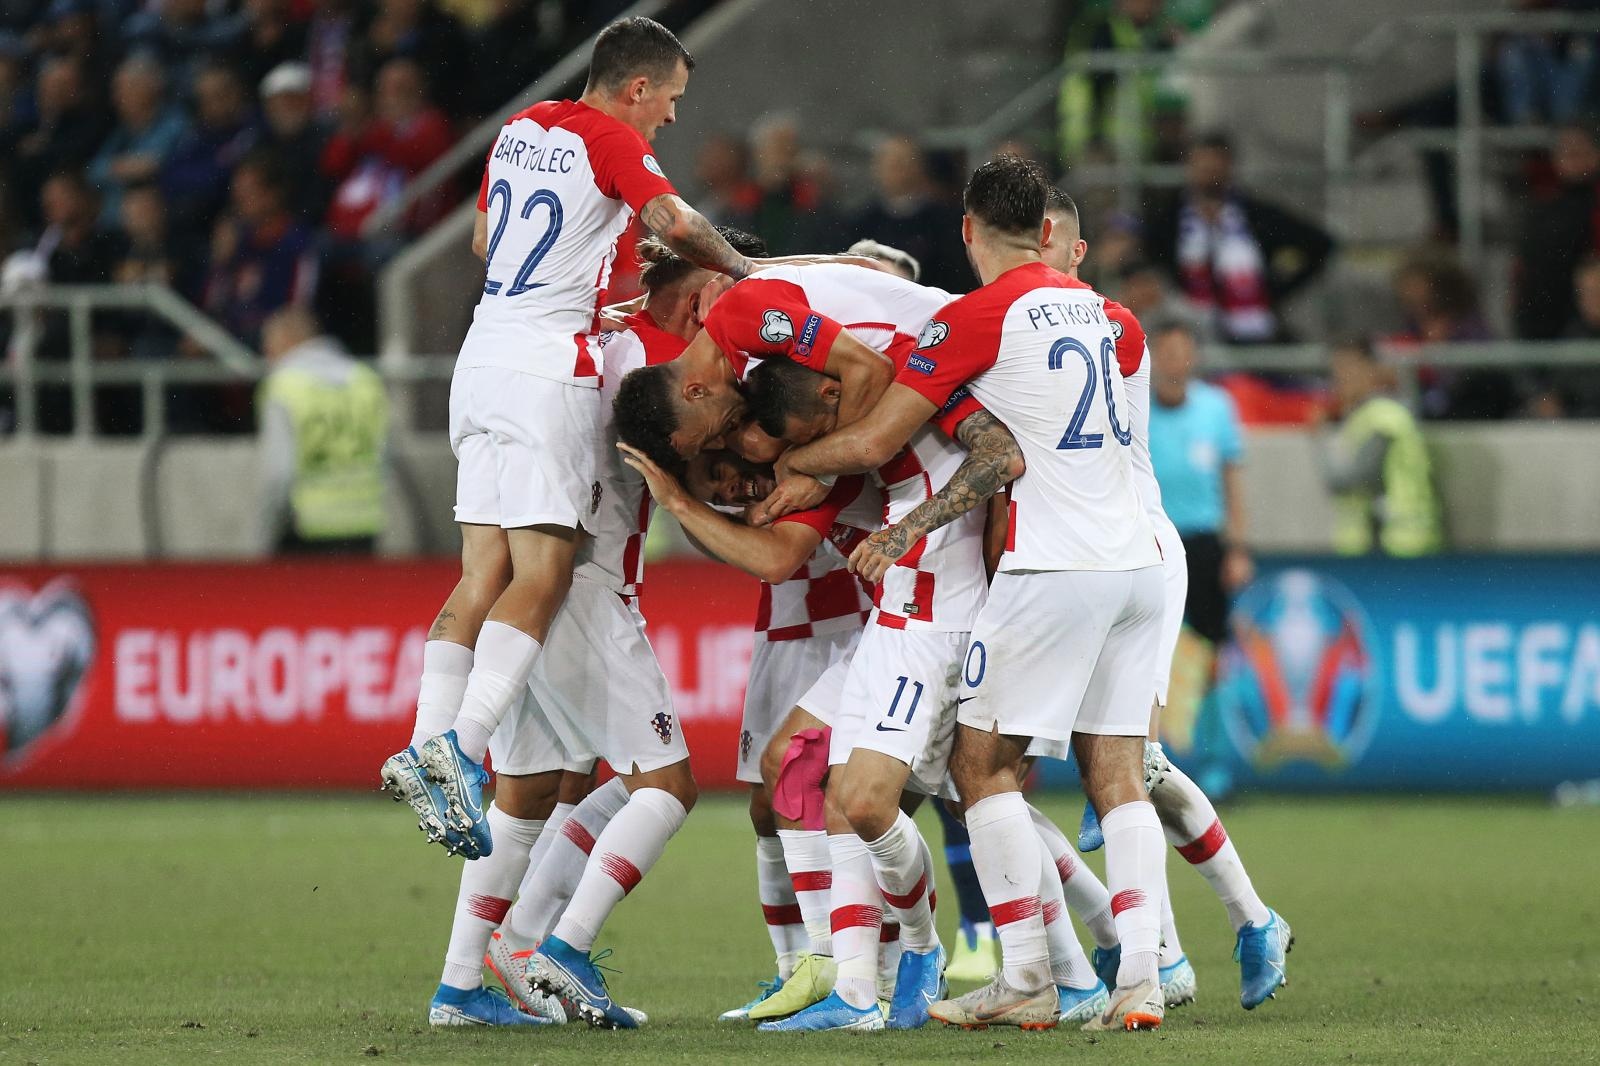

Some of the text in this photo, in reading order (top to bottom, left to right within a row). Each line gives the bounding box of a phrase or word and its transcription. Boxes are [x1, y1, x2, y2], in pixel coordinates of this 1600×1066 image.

[494, 134, 575, 174] BARTOLEC
[484, 178, 564, 296] 22
[802, 315, 819, 344] RESPECT
[1047, 336, 1132, 450] 20
[887, 676, 924, 725] 11
[1394, 622, 1600, 724] UEFA
